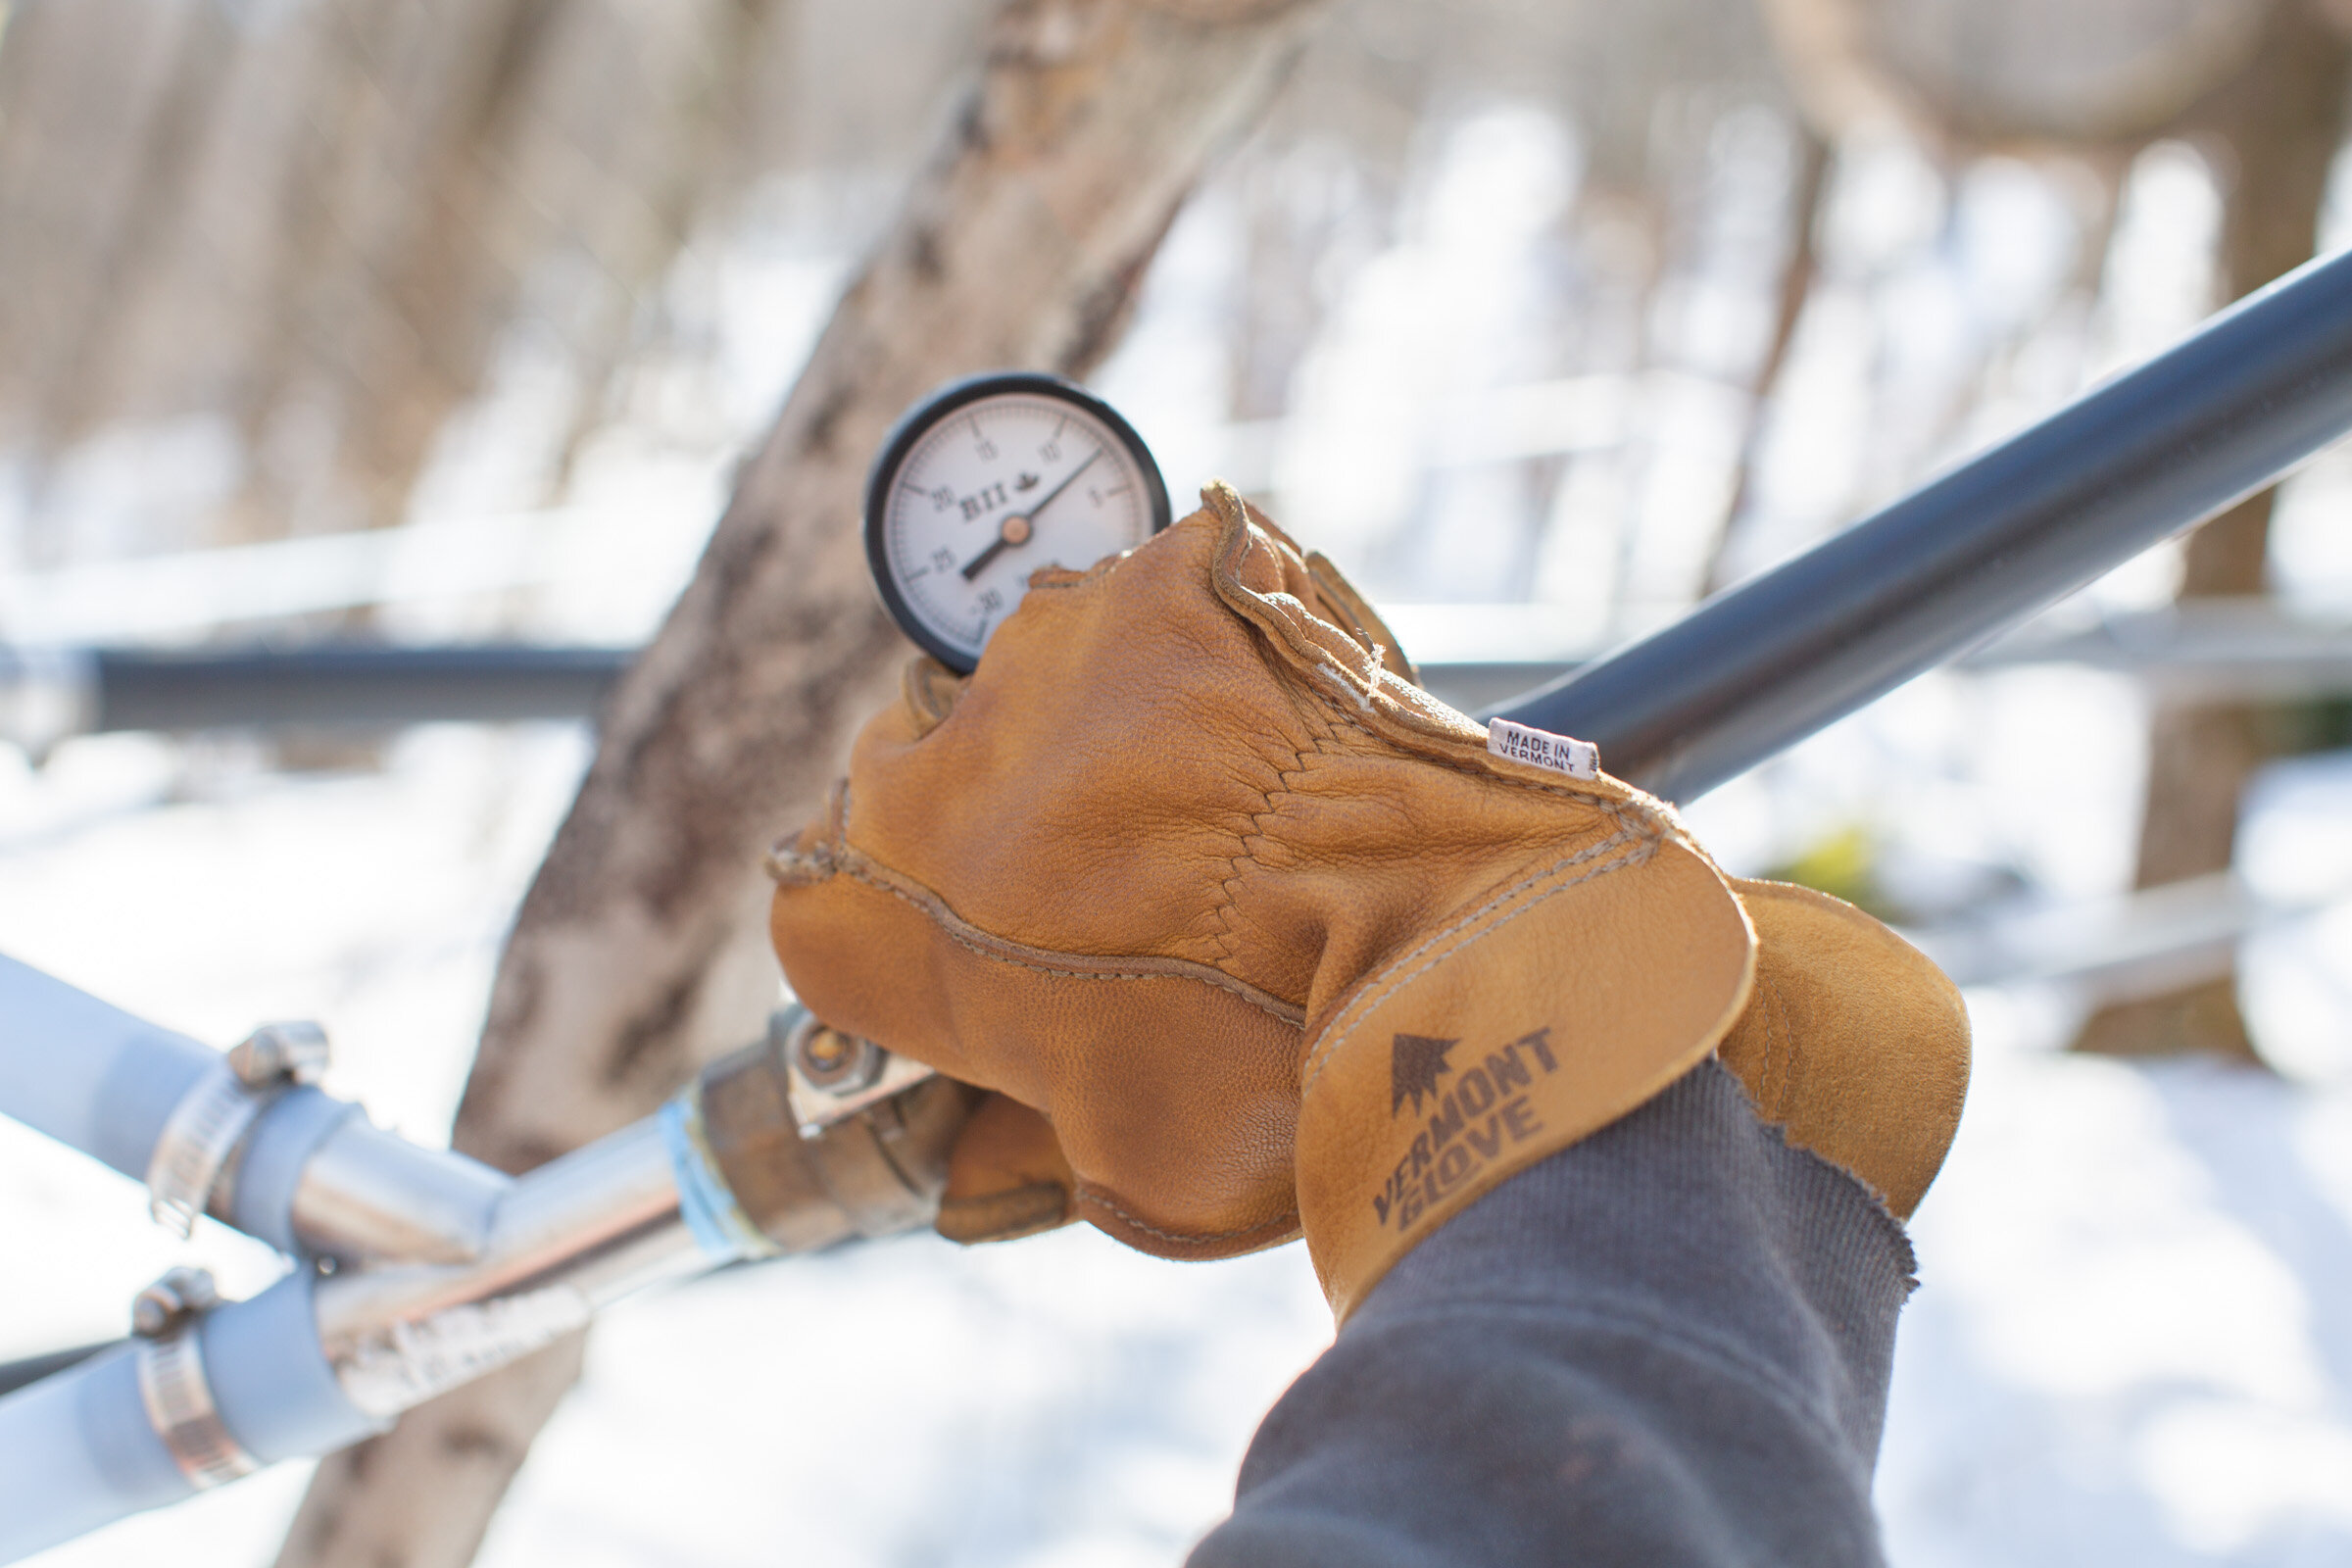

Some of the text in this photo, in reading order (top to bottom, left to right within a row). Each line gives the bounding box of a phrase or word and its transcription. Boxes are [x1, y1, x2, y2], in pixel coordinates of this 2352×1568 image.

[1499, 743, 1575, 772] VERMONT
[1507, 730, 1570, 760] MADE IN
[1373, 1026, 1558, 1226] VERMONT
[1398, 1095, 1544, 1232] GLOVE
